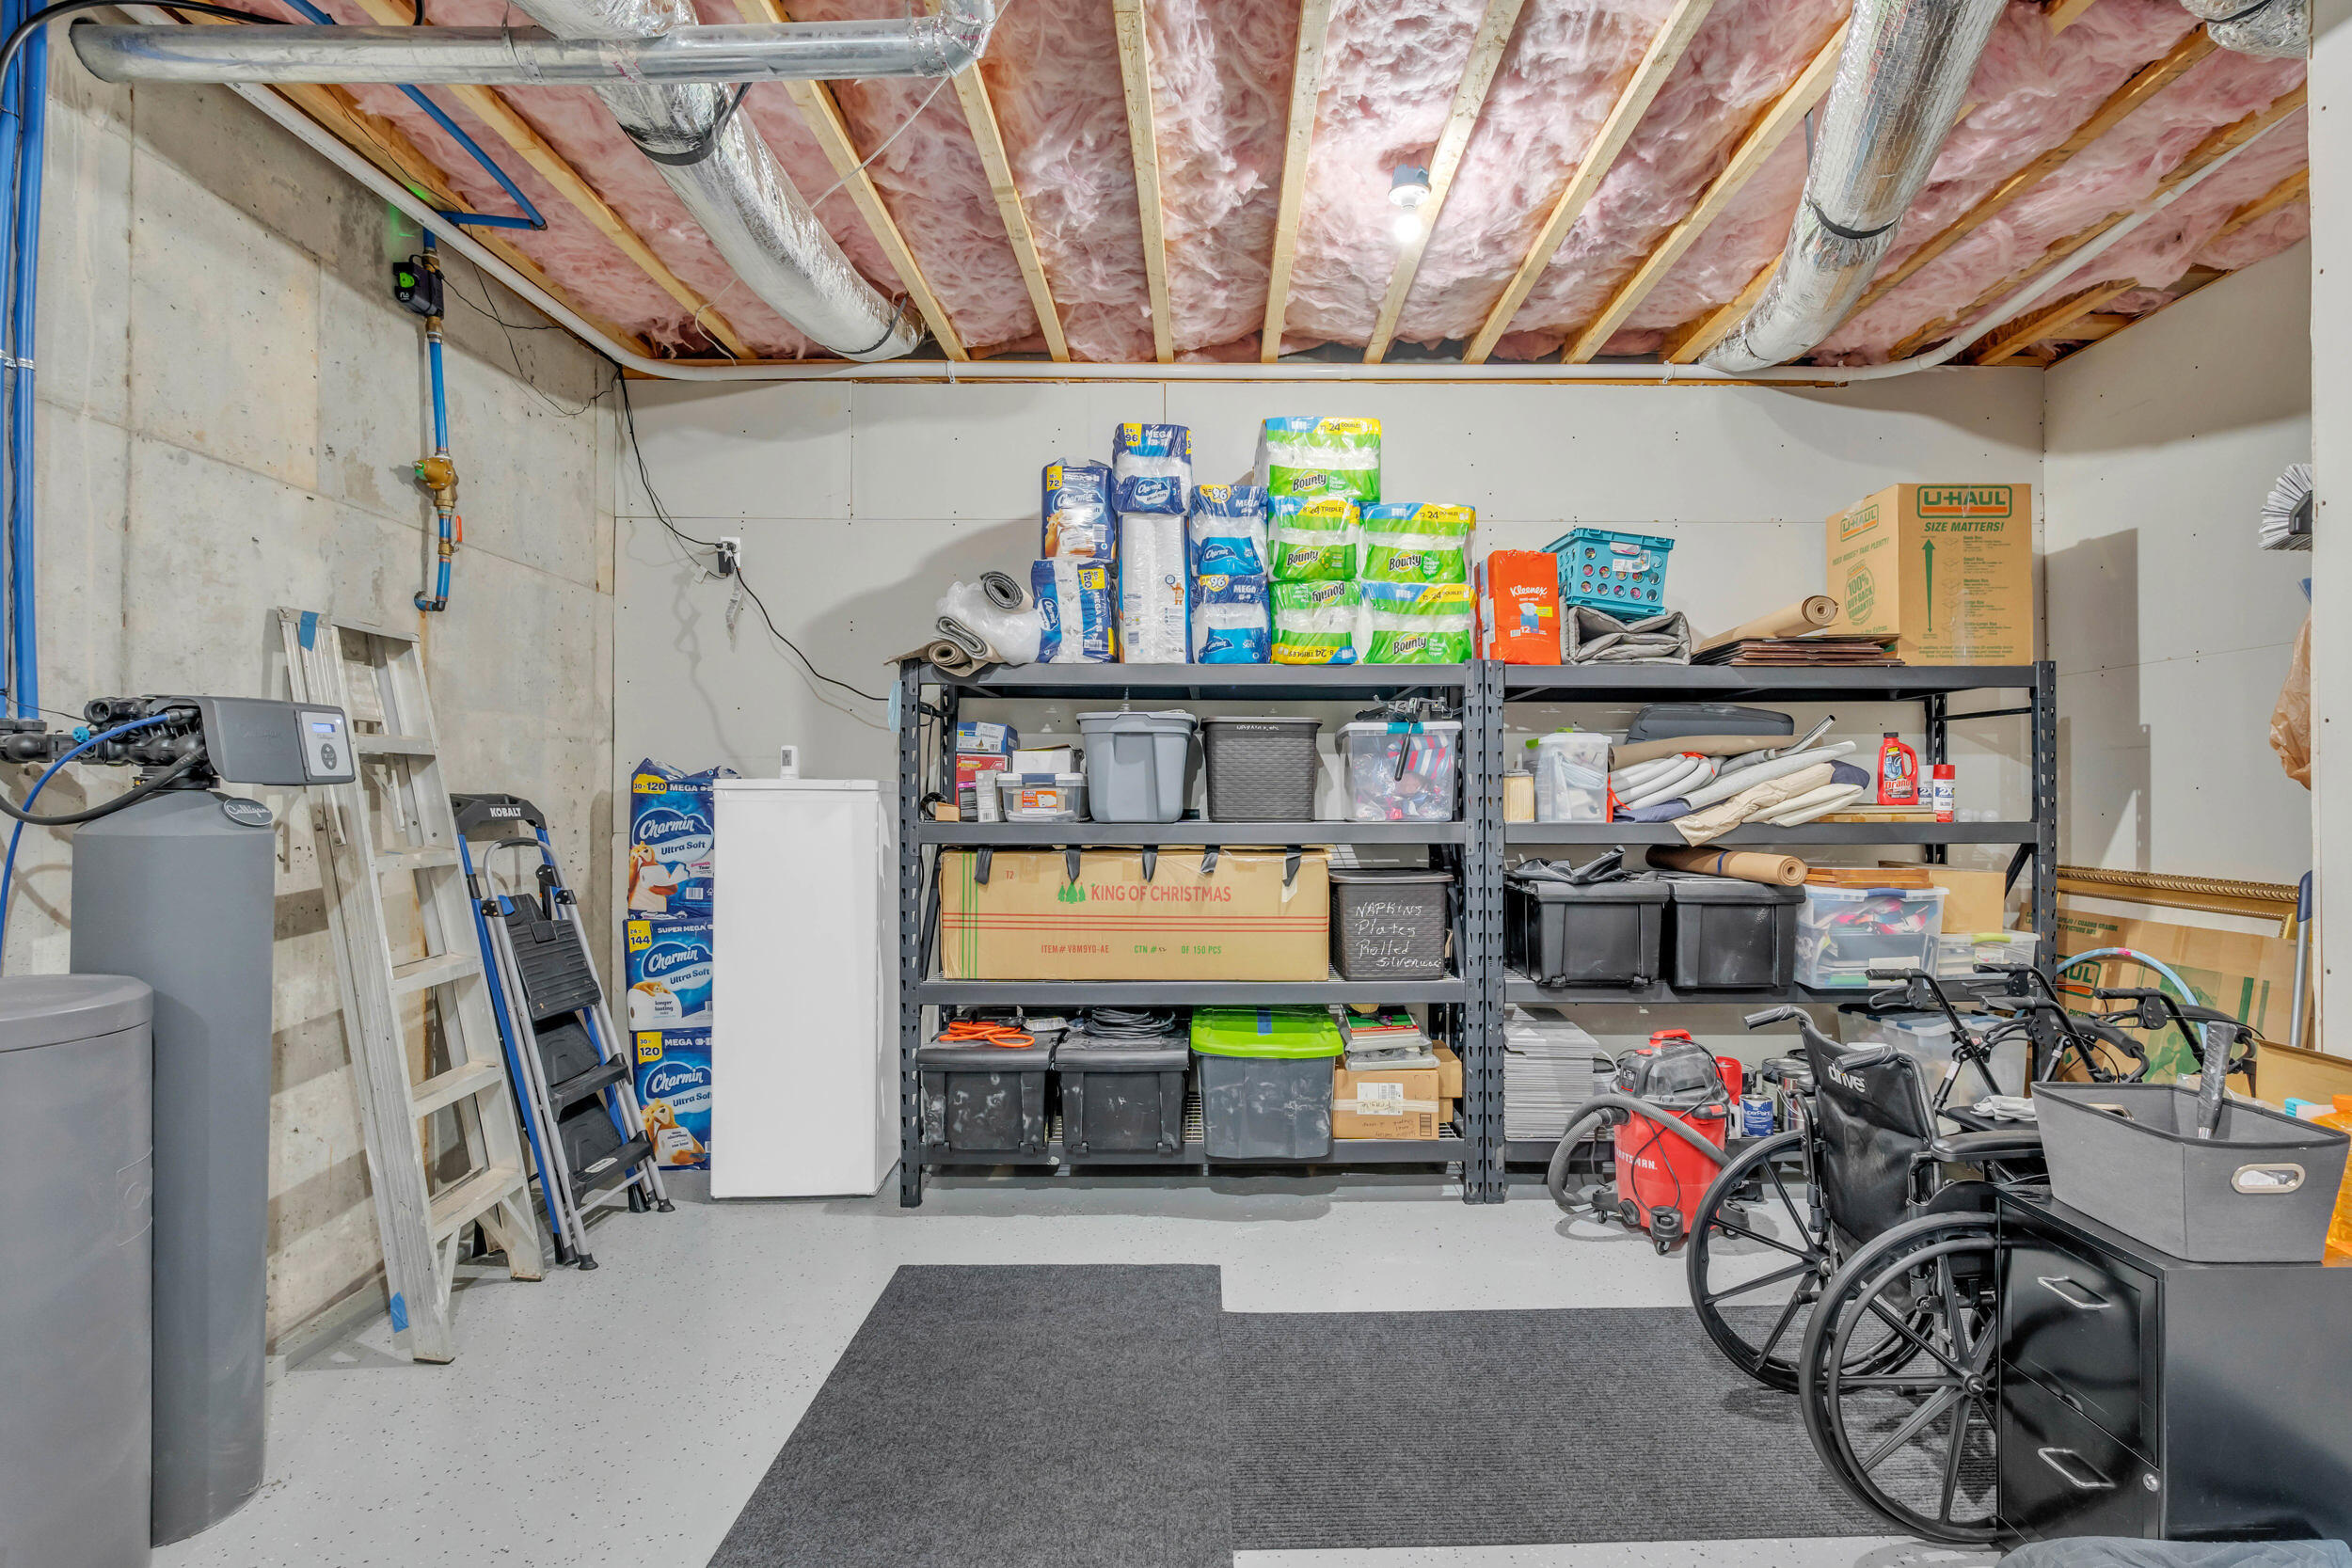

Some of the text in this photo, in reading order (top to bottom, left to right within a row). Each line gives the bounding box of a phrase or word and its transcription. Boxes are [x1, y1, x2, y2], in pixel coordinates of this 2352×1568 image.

[1146, 429, 1172, 438] MEGA
[1328, 423, 1341, 432] 24
[1125, 434, 1138, 442] 96
[1293, 473, 1327, 492] Bounty
[1212, 487, 1228, 500] 96
[1923, 491, 2006, 506] U-HAUL
[1235, 499, 1259, 508] MEGA
[1842, 509, 1876, 532] U-HAUL
[1924, 521, 2005, 532] SIZE MATTERS!
[1287, 550, 1319, 566] Bounty
[1389, 555, 1422, 571] Bounty
[1083, 571, 1093, 589] 120
[1210, 578, 1226, 588] 96
[1848, 574, 1869, 597] 100%
[1232, 585, 1257, 594] MEGA
[1311, 581, 1345, 602] Bounty
[1509, 585, 1548, 597] Kleenex
[1093, 593, 1103, 616] MEGA
[1315, 648, 1327, 657] 24
[1392, 637, 1427, 655] Bounty
[647, 783, 666, 791] 120
[1939, 786, 1953, 796] 2X
[226, 804, 271, 818] Culligan
[489, 807, 521, 817] KOBALT
[640, 815, 695, 839] Charmin
[660, 843, 685, 855] Ultra
[1005, 871, 1014, 880] T2
[1091, 884, 1232, 903] KING OF CHRISTMAS
[1355, 918, 1416, 938] Plates
[630, 936, 651, 944] 144
[1135, 944, 1148, 954] CTN
[1182, 945, 1189, 954] OF
[1193, 945, 1206, 955] 150
[1208, 945, 1221, 955] PCS
[1356, 939, 1409, 959] Rolled
[648, 946, 698, 973] Charmin
[670, 969, 709, 984] Ultra Soft
[640, 1047, 660, 1055] 120
[651, 1069, 704, 1093] Charmin
[1829, 1063, 1866, 1093] drive
[673, 1092, 711, 1107] Ultra Sof
